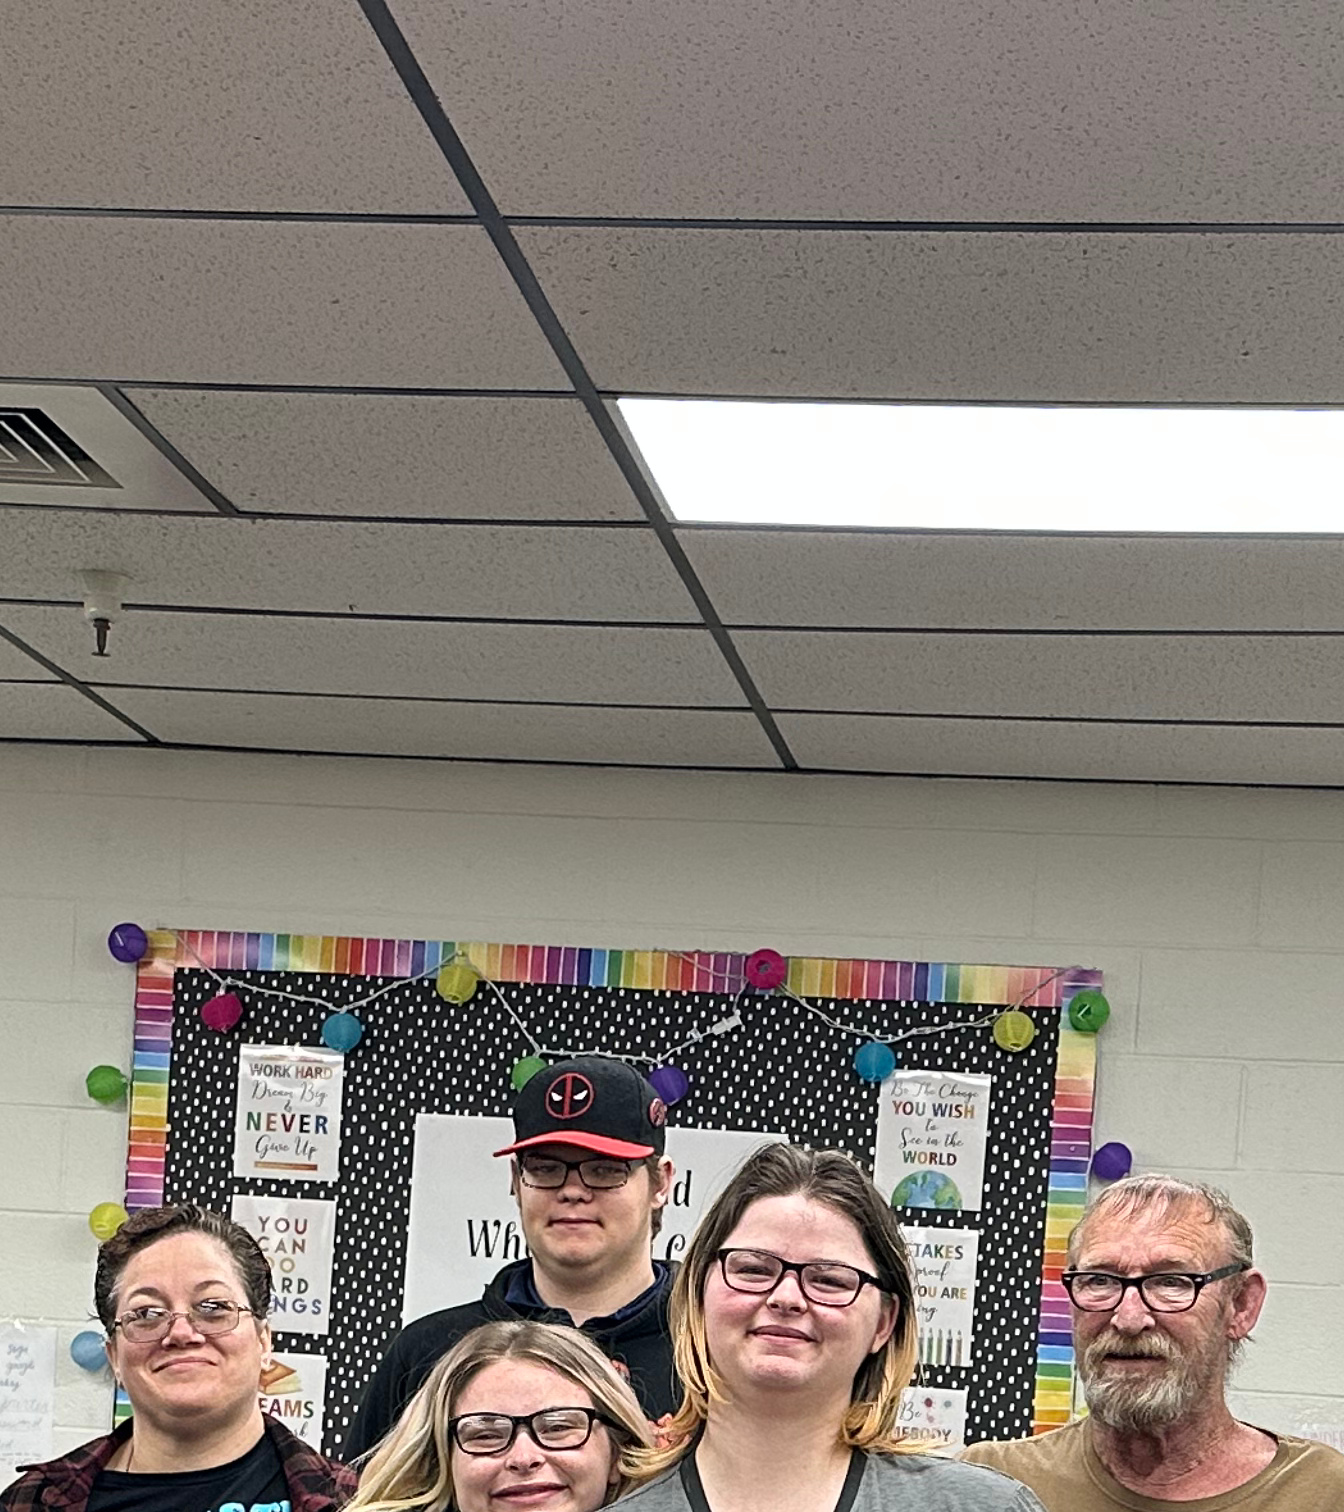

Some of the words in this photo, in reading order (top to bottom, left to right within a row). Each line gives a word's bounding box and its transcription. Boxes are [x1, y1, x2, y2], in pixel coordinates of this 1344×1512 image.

[249, 1063, 291, 1079] WORK
[295, 1065, 333, 1080] HARD
[251, 1080, 293, 1100] Dream
[300, 1081, 328, 1107] Big
[891, 1080, 910, 1097] Be
[892, 1100, 926, 1116] YOU
[932, 1103, 975, 1119] WISH
[246, 1111, 328, 1135] NEVER
[255, 1134, 290, 1159] Give
[294, 1136, 318, 1161] Up
[899, 1127, 921, 1150] See
[944, 1131, 964, 1147] the
[903, 1151, 957, 1166] WORLD
[258, 1216, 308, 1235] YOU
[258, 1236, 306, 1255] CAN
[941, 1287, 968, 1299] ARE
[258, 1397, 314, 1418] EAMS
[899, 1401, 921, 1421] Be
